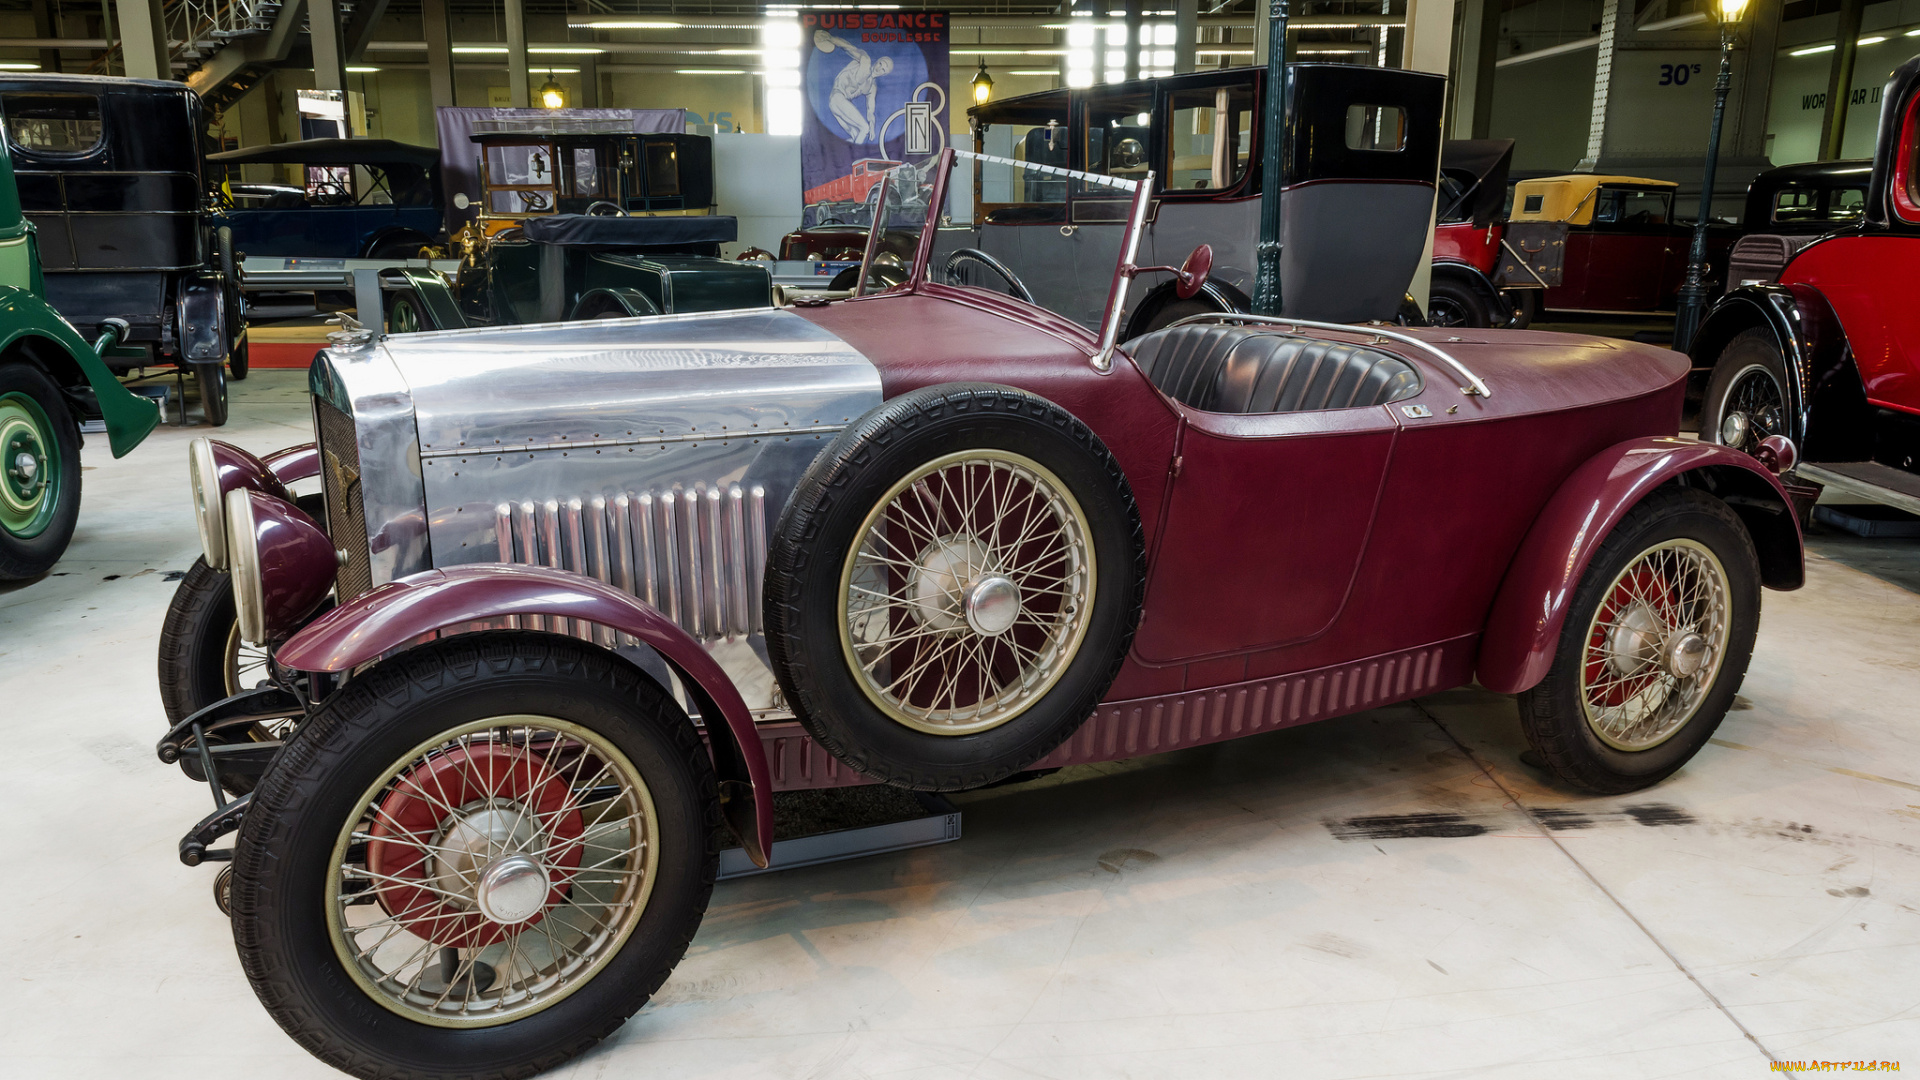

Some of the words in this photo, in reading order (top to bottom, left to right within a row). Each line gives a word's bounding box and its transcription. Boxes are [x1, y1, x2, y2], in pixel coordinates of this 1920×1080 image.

[803, 13, 944, 29] PUISSANCE
[861, 33, 941, 43] SOUPLESSE
[1802, 93, 1827, 110] WOR
[1850, 89, 1868, 105] AR
[1870, 87, 1881, 104] II
